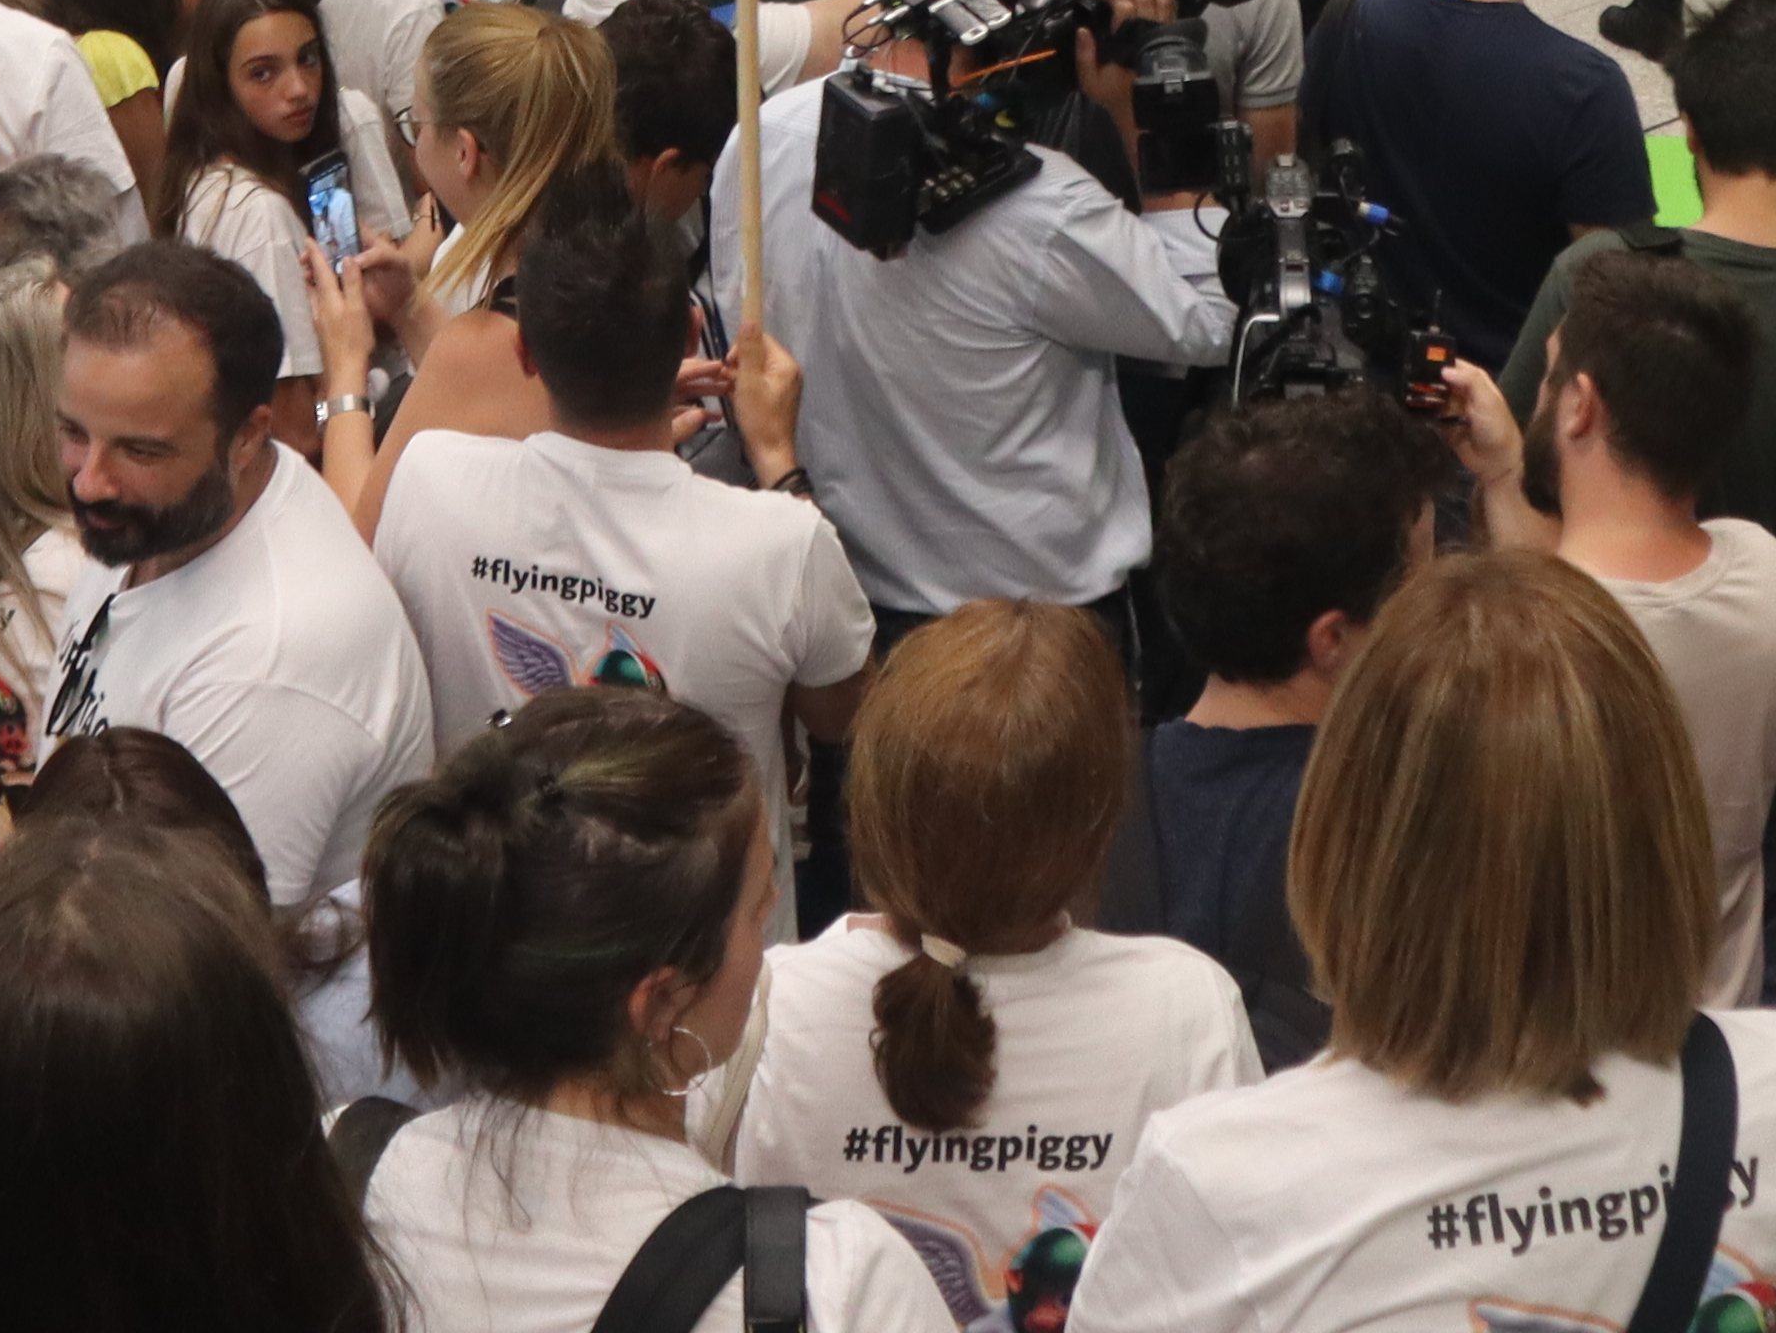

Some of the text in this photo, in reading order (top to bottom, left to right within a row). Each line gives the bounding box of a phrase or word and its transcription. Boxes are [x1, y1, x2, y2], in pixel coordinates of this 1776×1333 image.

[471, 555, 656, 620] #flyingpiggy
[843, 1123, 1113, 1174] #flyingpiggy
[1427, 1156, 1759, 1257] #flyingpiy
